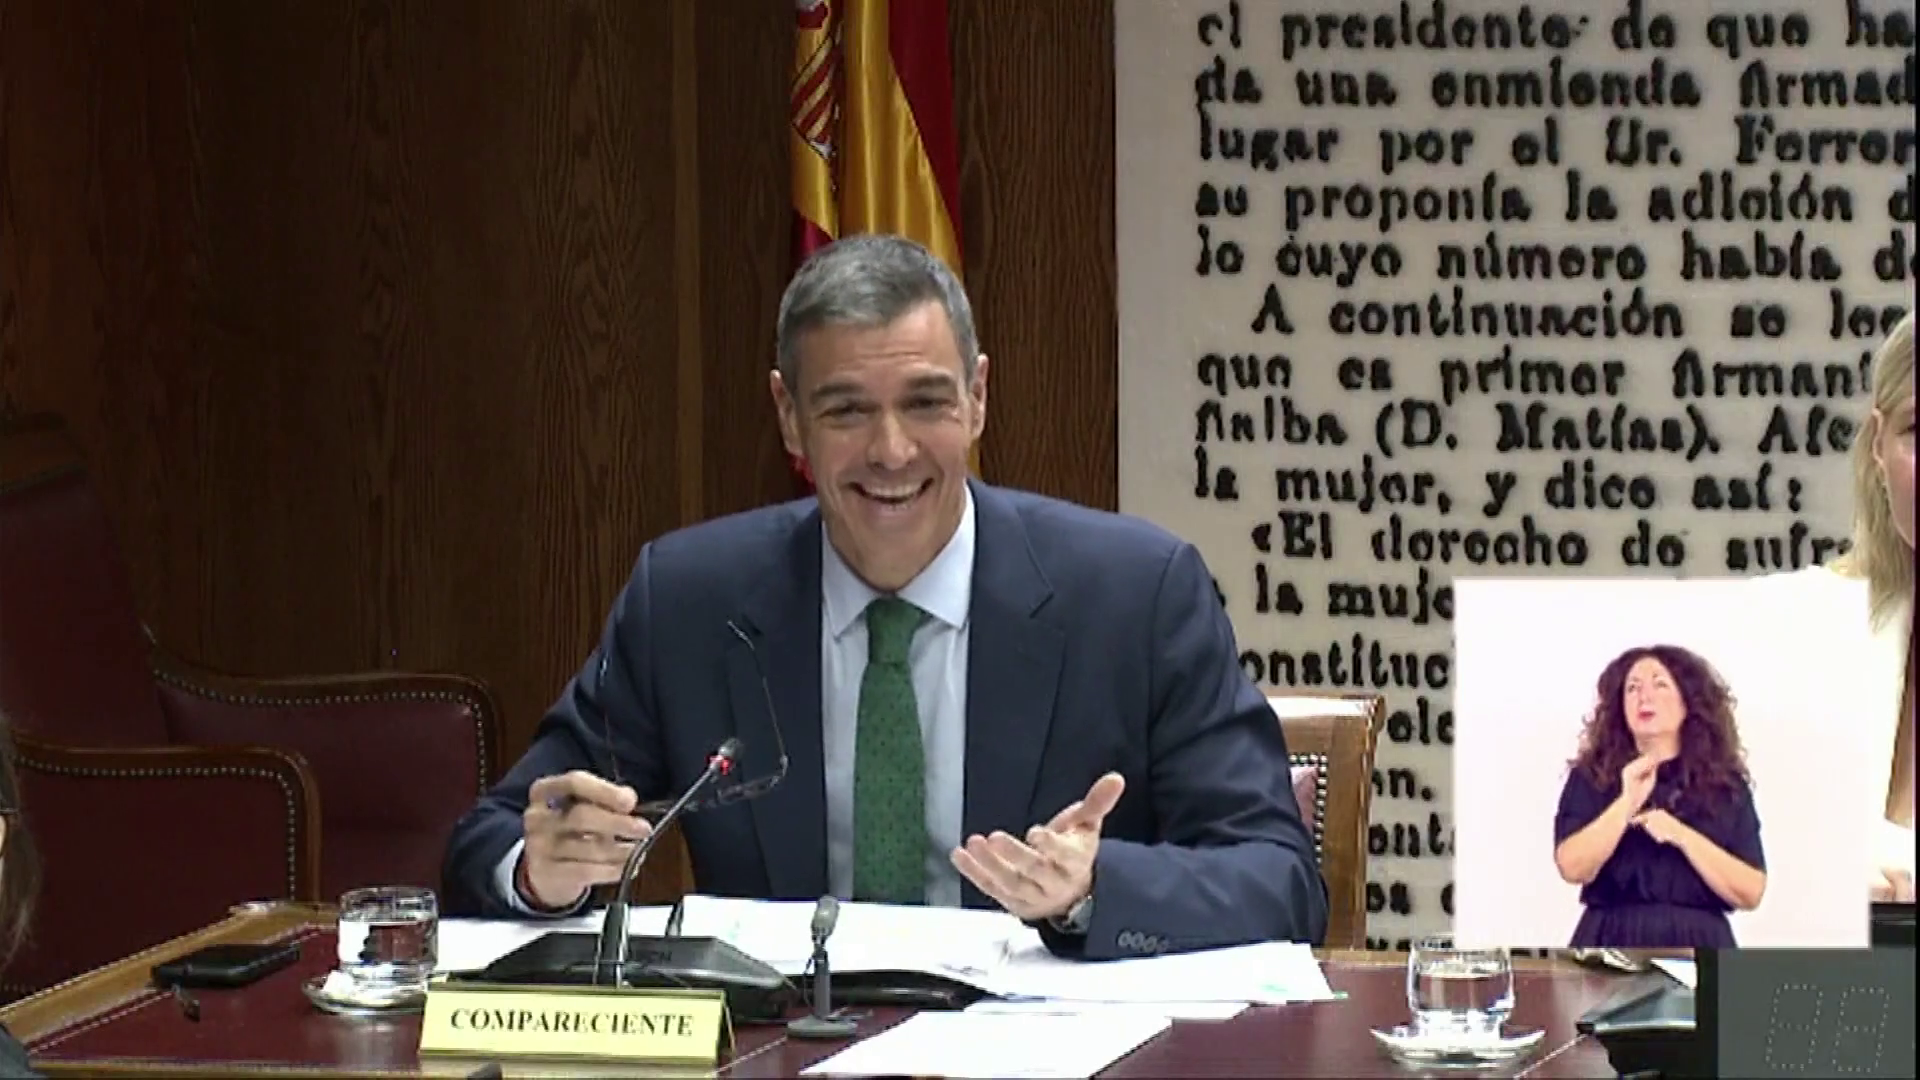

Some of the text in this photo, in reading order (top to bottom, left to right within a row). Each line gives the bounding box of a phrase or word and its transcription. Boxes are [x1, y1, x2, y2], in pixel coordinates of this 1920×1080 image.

[1198, 108, 1339, 172] lugar
[1378, 128, 1475, 176] por
[1565, 168, 1618, 223] la
[1195, 223, 1245, 279] lo
[1873, 228, 1914, 283] d
[1250, 283, 1295, 337] A
[1194, 444, 1240, 502] la
[1483, 471, 1518, 518] y
[1255, 563, 1304, 614] la
[1241, 634, 1455, 690] onstituc
[450, 1007, 693, 1037] COMPARECIENTE
